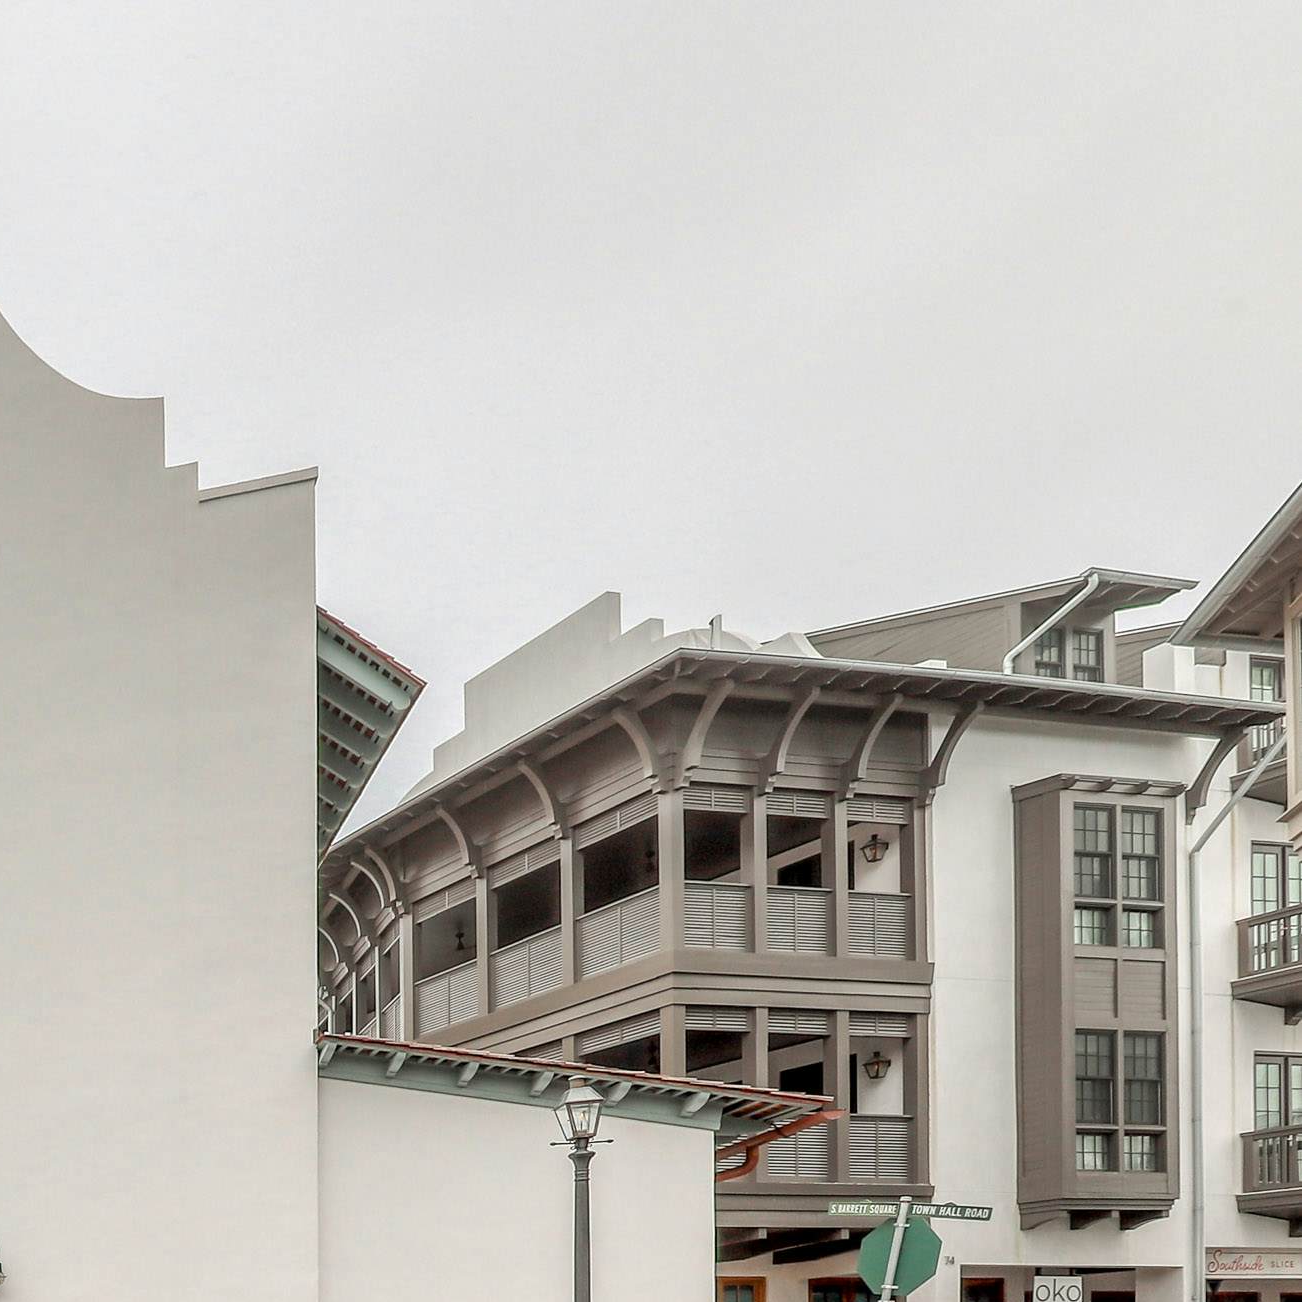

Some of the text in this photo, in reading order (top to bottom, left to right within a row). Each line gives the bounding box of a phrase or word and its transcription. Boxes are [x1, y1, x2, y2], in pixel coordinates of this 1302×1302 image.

[869, 1204, 897, 1214] SQUARE
[911, 1205, 989, 1218] TOWN HALL ROAD
[1208, 1249, 1295, 1273] Southside SLICE
[1036, 1279, 1081, 1302] oko
